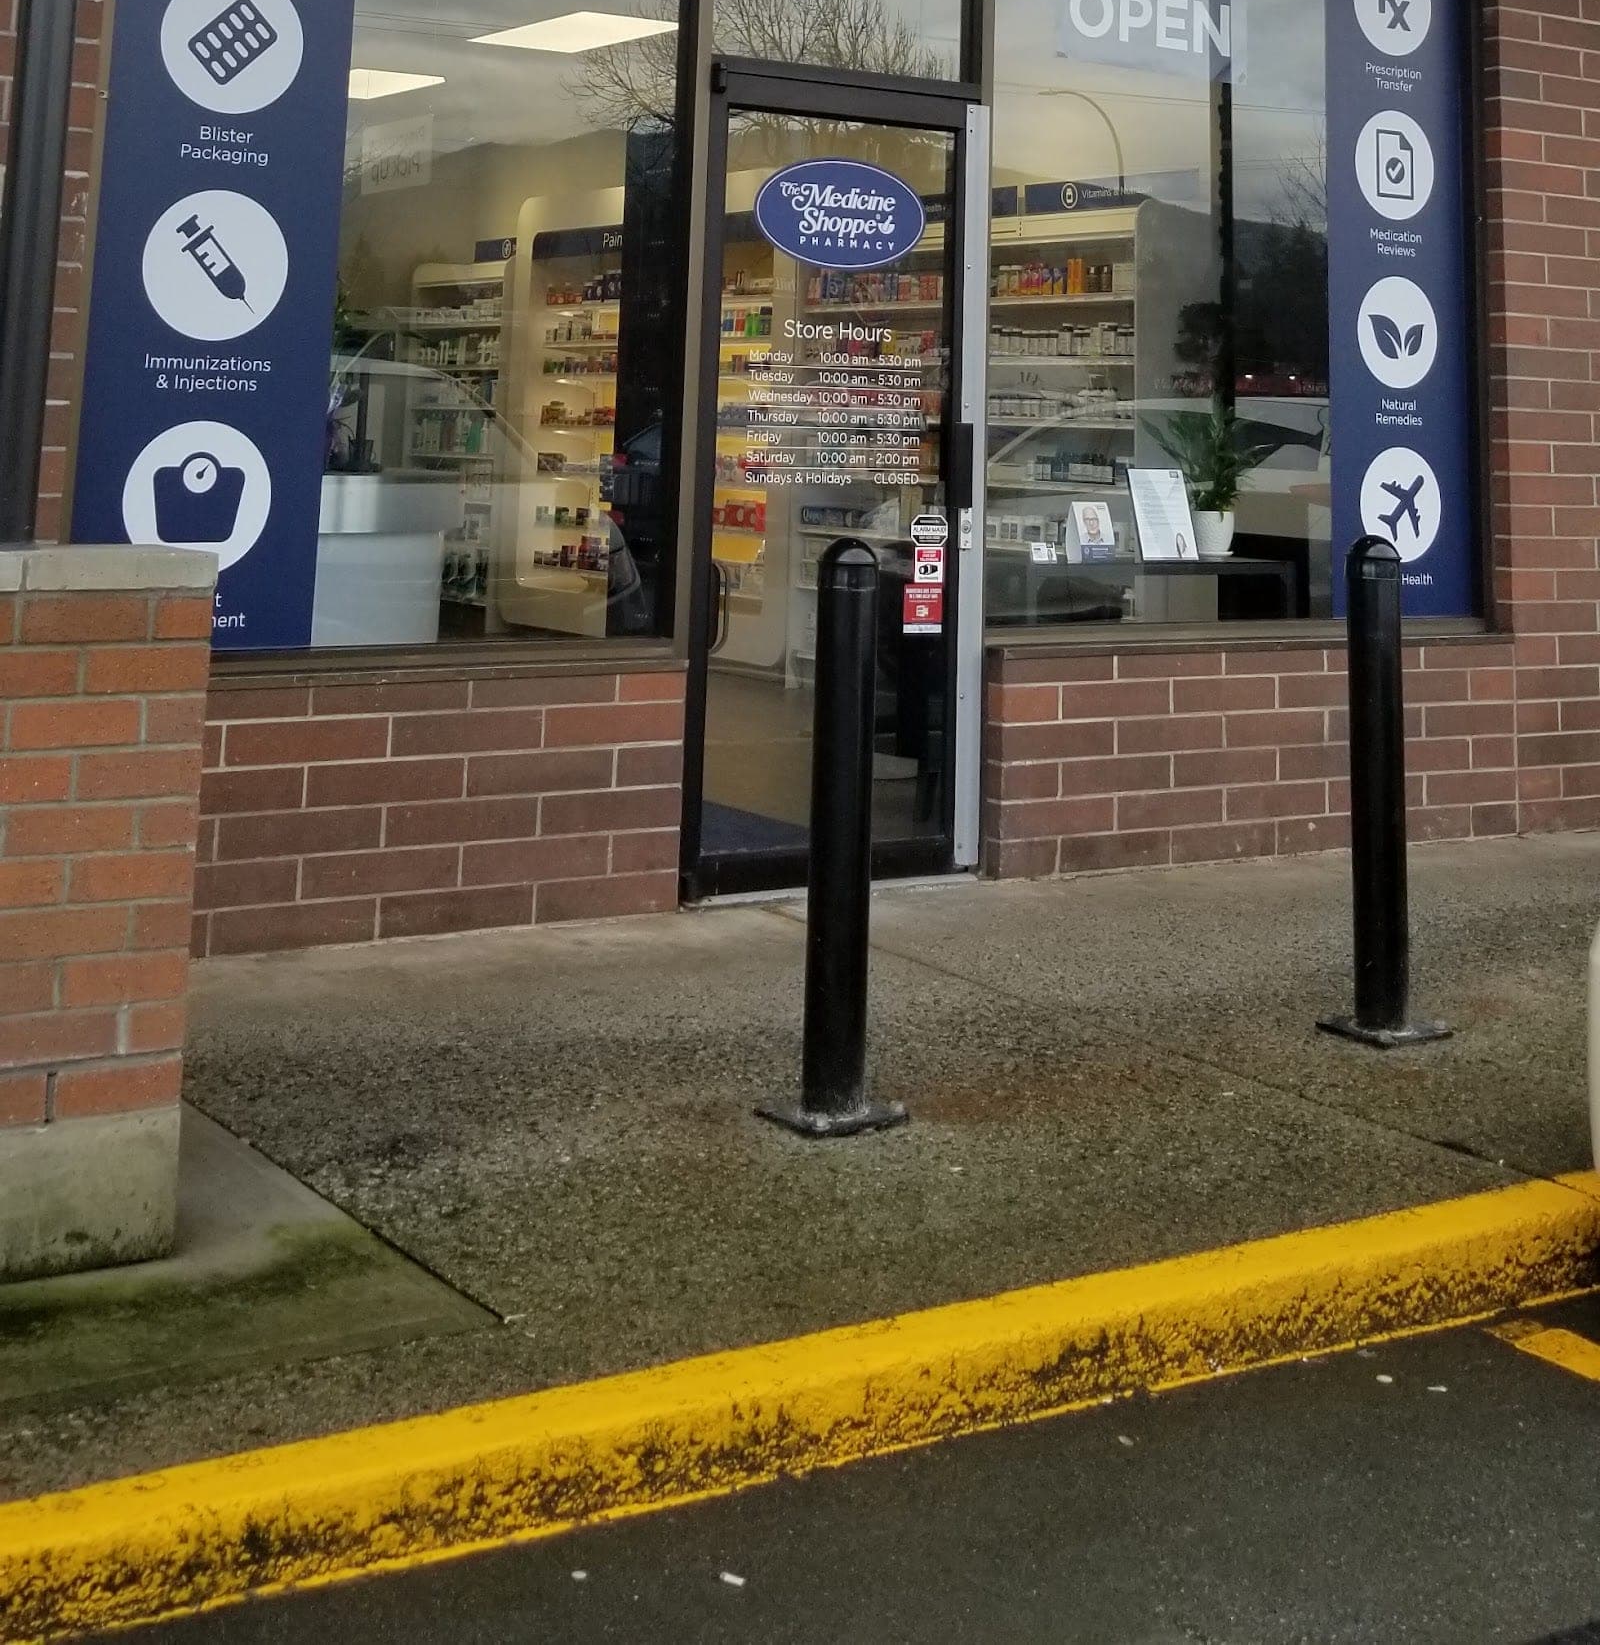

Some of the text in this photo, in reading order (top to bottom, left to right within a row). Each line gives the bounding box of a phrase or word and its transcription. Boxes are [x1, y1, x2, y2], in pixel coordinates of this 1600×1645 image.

[1365, 61, 1422, 80] Prescription
[1375, 77, 1413, 92] Transfer
[200, 126, 253, 145] Blister
[180, 144, 269, 166] Packaging
[779, 181, 896, 212] The Medicine
[799, 207, 877, 238] Shoppe
[602, 232, 623, 249] Pain
[800, 235, 895, 251] PHARMACY
[1369, 228, 1422, 244] Medication
[1377, 243, 1416, 258] Reviews
[783, 319, 892, 343] Store Hours
[144, 353, 272, 373] Immunizations
[749, 349, 794, 364] Monday
[820, 352, 849, 365] 10:00
[851, 356, 869, 366] am
[879, 355, 902, 366] 5:30
[904, 357, 922, 369] pm
[155, 374, 258, 392] & Injections
[748, 369, 794, 384] Tuesday
[819, 372, 849, 384] 10:00
[851, 375, 868, 385] am
[878, 374, 901, 386] 5:30
[903, 377, 921, 388] pm
[748, 389, 813, 405] Wednesday
[818, 391, 848, 404] 10:00
[850, 394, 868, 405] am
[877, 393, 901, 406] 5:30
[903, 396, 921, 408] pm
[1381, 398, 1417, 411] Natural
[747, 409, 798, 425] Thursday
[817, 411, 848, 424] 10:00
[850, 415, 867, 425] am
[877, 413, 900, 425] 5:30
[902, 416, 920, 427] pm
[1375, 413, 1423, 427] Remedies
[746, 430, 782, 445] Friday
[817, 431, 848, 444] 10:00
[849, 435, 867, 445] am
[876, 433, 900, 445] 5:30
[902, 436, 920, 447] pm
[745, 450, 795, 465] Saturday
[816, 452, 847, 464] 10:00
[849, 454, 866, 465] am
[875, 453, 900, 465] 2:00
[902, 455, 920, 467] pm
[745, 471, 919, 486] Sundays & Holidays CLOSED
[1401, 572, 1433, 586] Health
